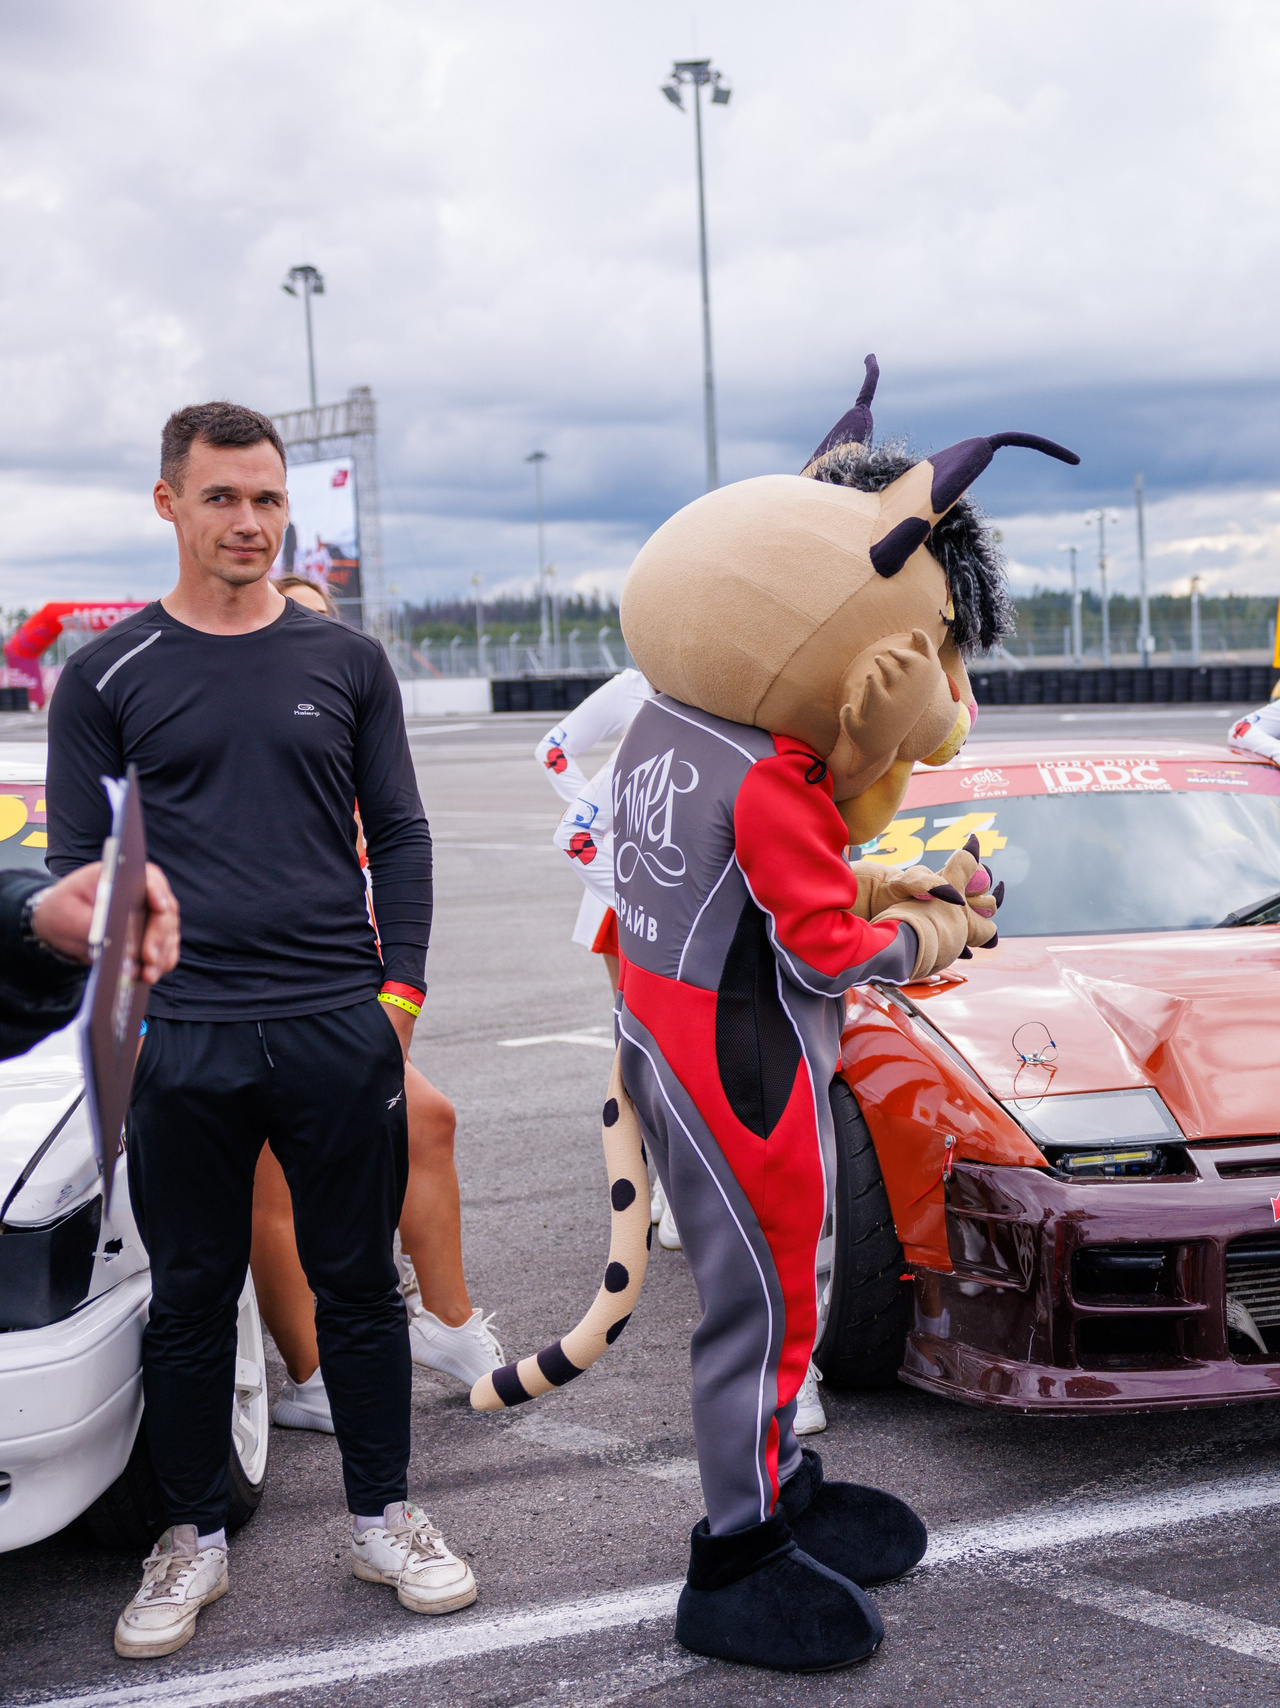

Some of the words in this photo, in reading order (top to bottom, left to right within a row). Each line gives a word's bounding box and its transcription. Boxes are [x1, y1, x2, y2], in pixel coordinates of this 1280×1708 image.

[1036, 760, 1094, 769] IGORA
[1104, 758, 1158, 767] DRIVE
[1038, 766, 1167, 788] IDDC
[1048, 785, 1088, 794] DRIFT
[1091, 782, 1173, 792] CHALLENGE
